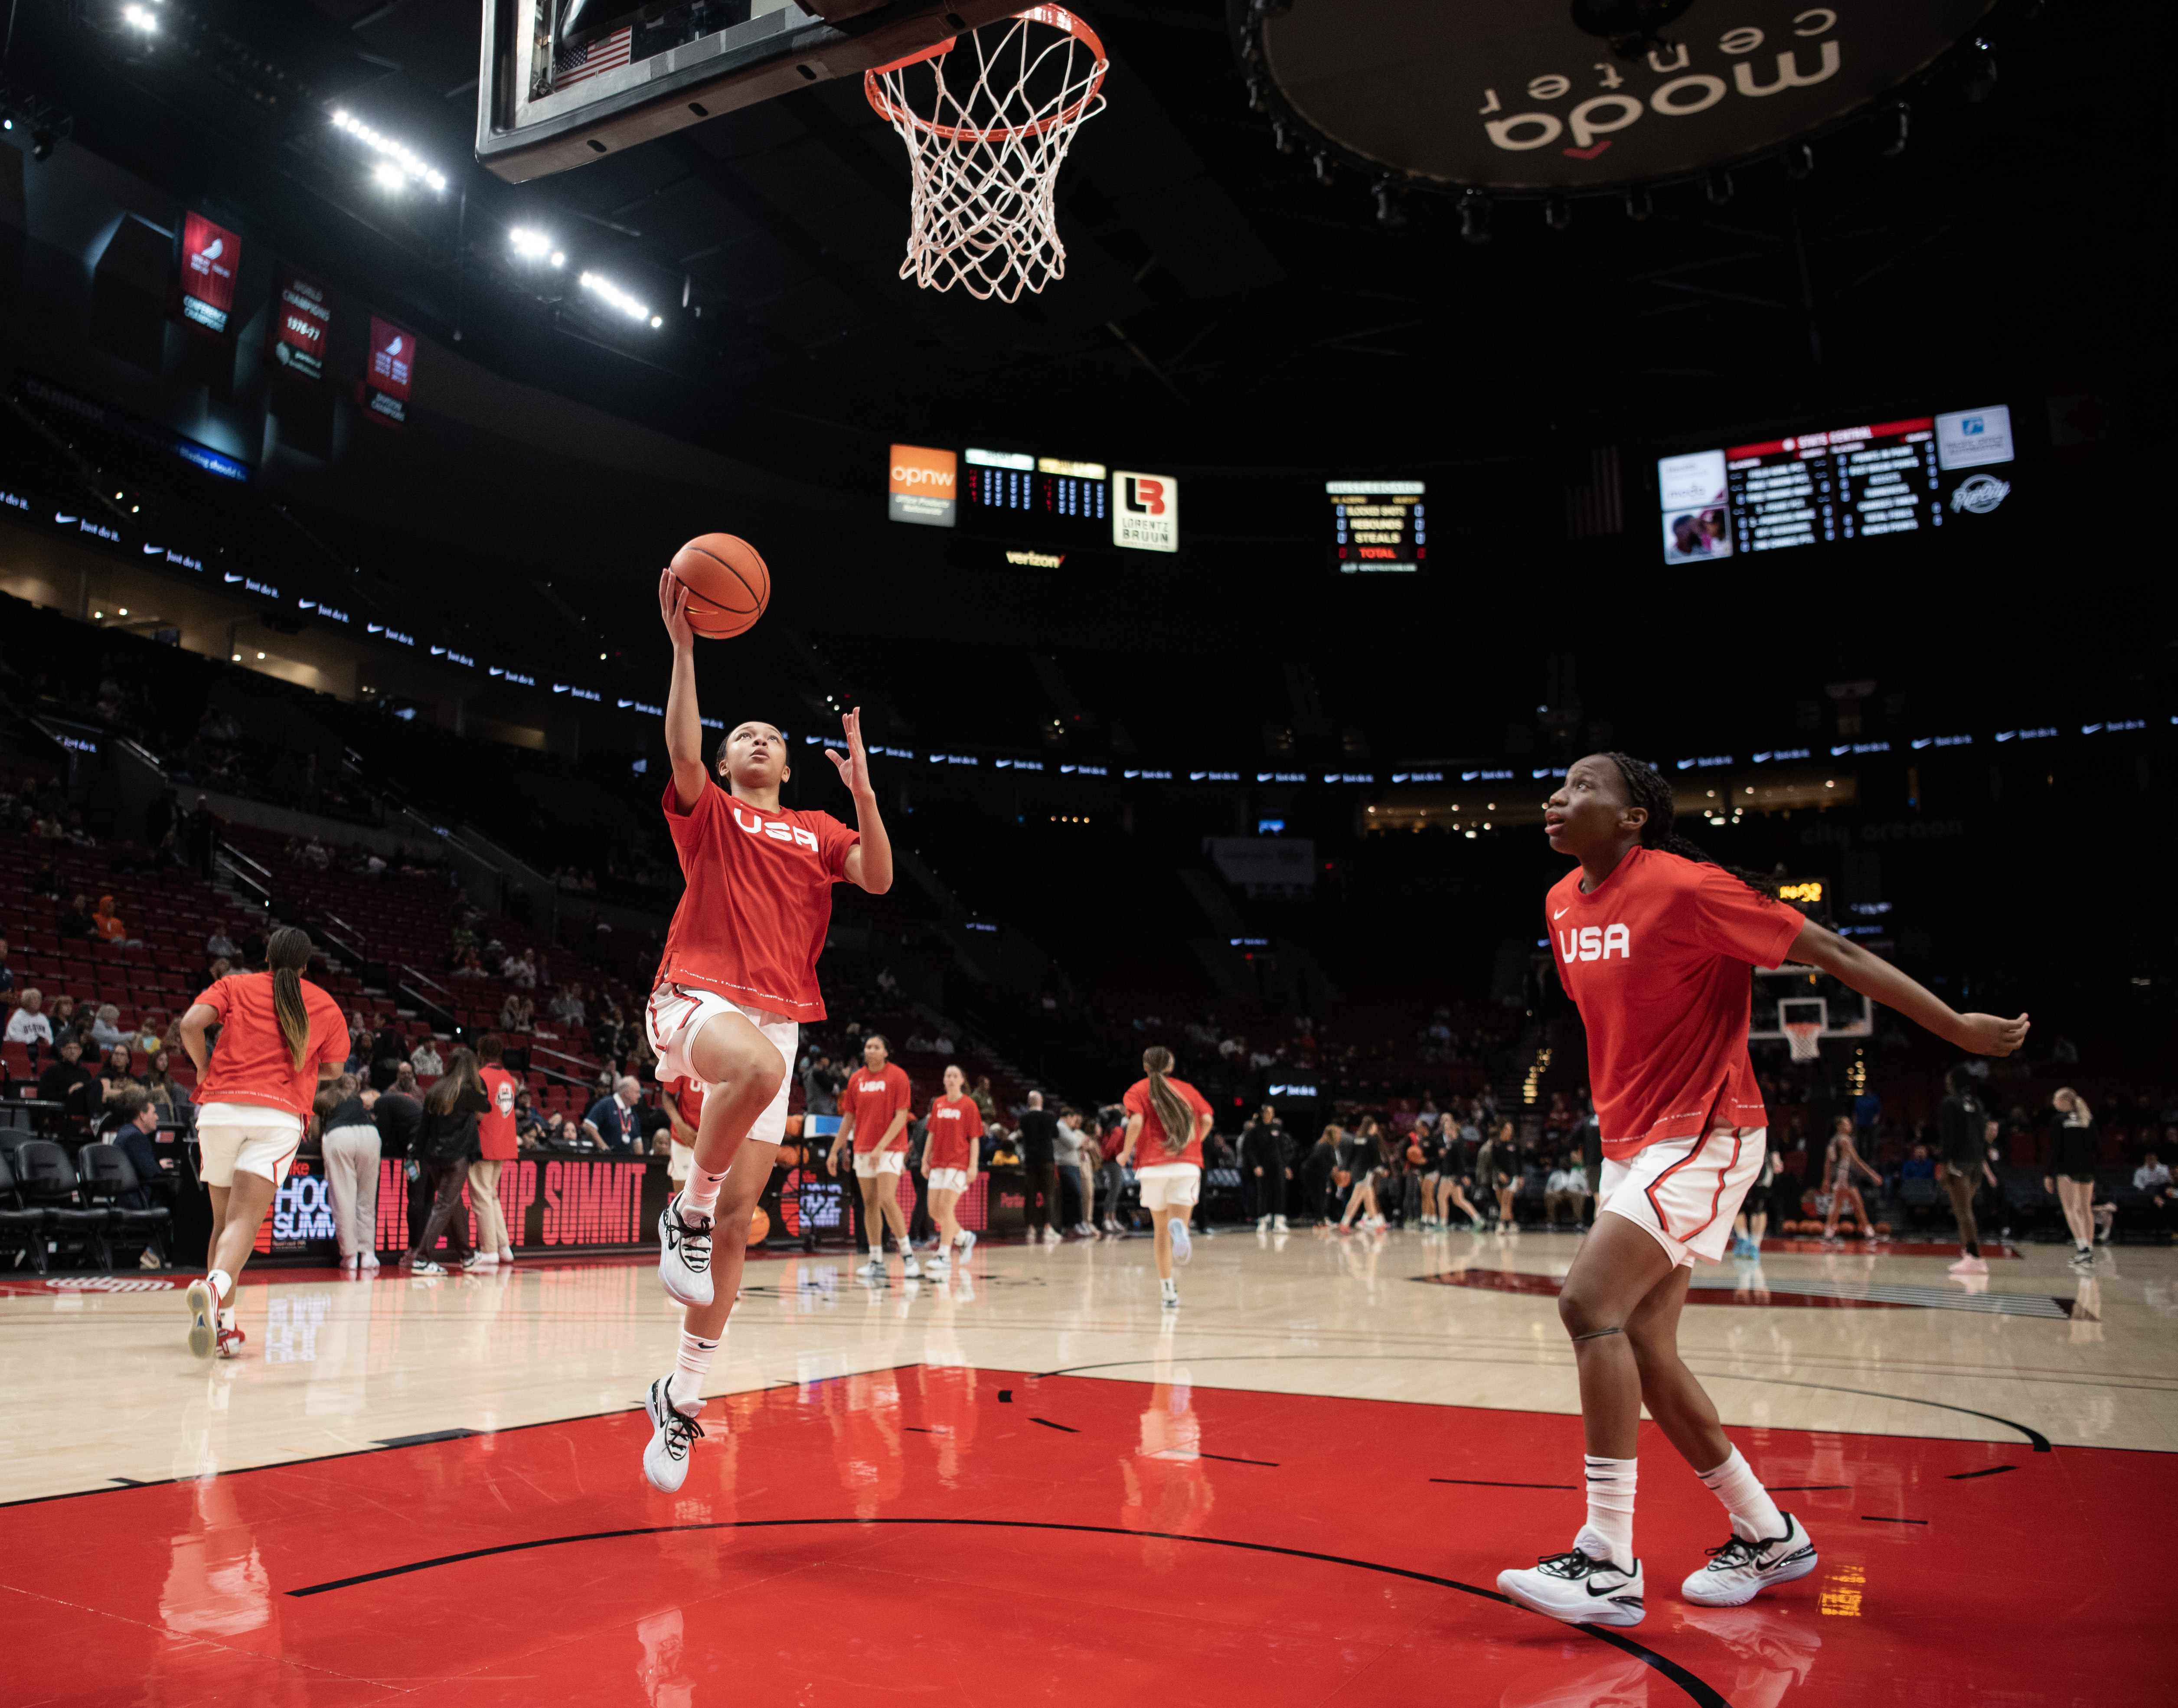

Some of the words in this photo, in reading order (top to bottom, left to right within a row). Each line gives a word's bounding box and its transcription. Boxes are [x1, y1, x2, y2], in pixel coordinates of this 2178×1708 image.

[1479, 7, 1837, 115] center
[1484, 40, 1841, 152] moda
[282, 288, 330, 322] CHAMPIONS
[287, 315, 320, 341] 1976-77
[1797, 432, 1828, 449] STATS
[1829, 426, 1872, 444] CENTRAL
[891, 465, 955, 487] opnw
[6, 493, 20, 506] do
[20, 497, 29, 510] it.
[80, 519, 98, 534] Just
[98, 526, 111, 539] do
[111, 529, 121, 542] it.
[1122, 518, 1169, 532] LORENTZ
[1123, 529, 1169, 543] BRUUN
[1354, 531, 1401, 543] STEALS
[167, 549, 183, 564] Just
[183, 555, 194, 568] do
[195, 559, 203, 572] it.
[1006, 551, 1059, 568] verizon
[1359, 547, 1398, 558] TOTAL
[245, 577, 260, 591] Just
[261, 583, 271, 595] do
[318, 603, 332, 617] Just
[332, 609, 342, 620] do
[385, 627, 398, 640] Just
[398, 633, 408, 643] do
[700, 716, 709, 726] ust
[64, 736, 78, 749] Just
[78, 739, 89, 751] do
[89, 742, 98, 754] it.
[734, 807, 819, 852] USA
[1559, 923, 1630, 963] USA
[685, 970, 705, 980] PLURIBUS
[859, 1081, 886, 1092] USA
[937, 1107, 961, 1120] USA
[542, 1160, 647, 1246] SUMMIT
[273, 1212, 336, 1240] SUMM
